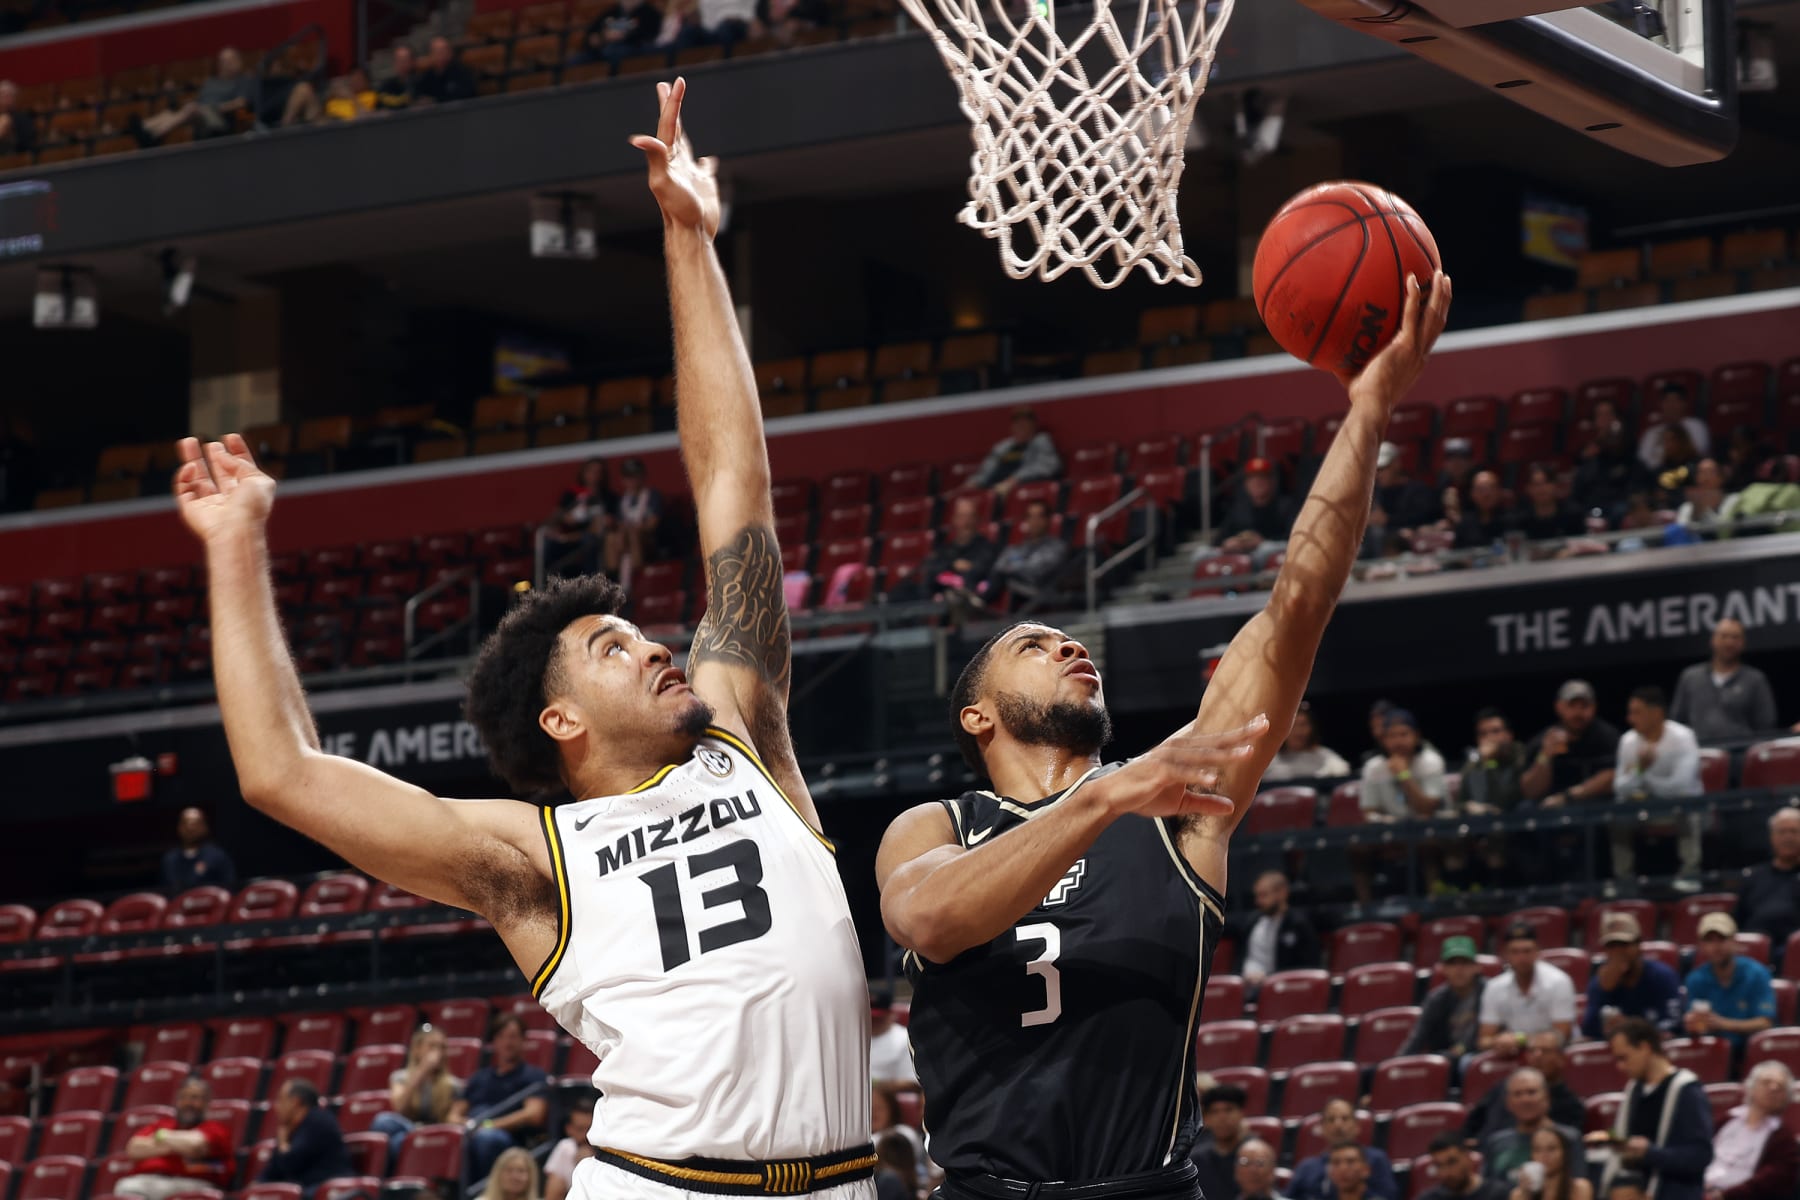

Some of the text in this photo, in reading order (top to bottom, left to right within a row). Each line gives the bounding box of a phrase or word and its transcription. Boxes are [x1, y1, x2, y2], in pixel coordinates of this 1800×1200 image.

[1488, 608, 1571, 653] THE
[366, 721, 488, 767] AMER
[595, 789, 762, 877] MIZZOU
[638, 838, 773, 973] 13
[1015, 921, 1062, 1028] 3
